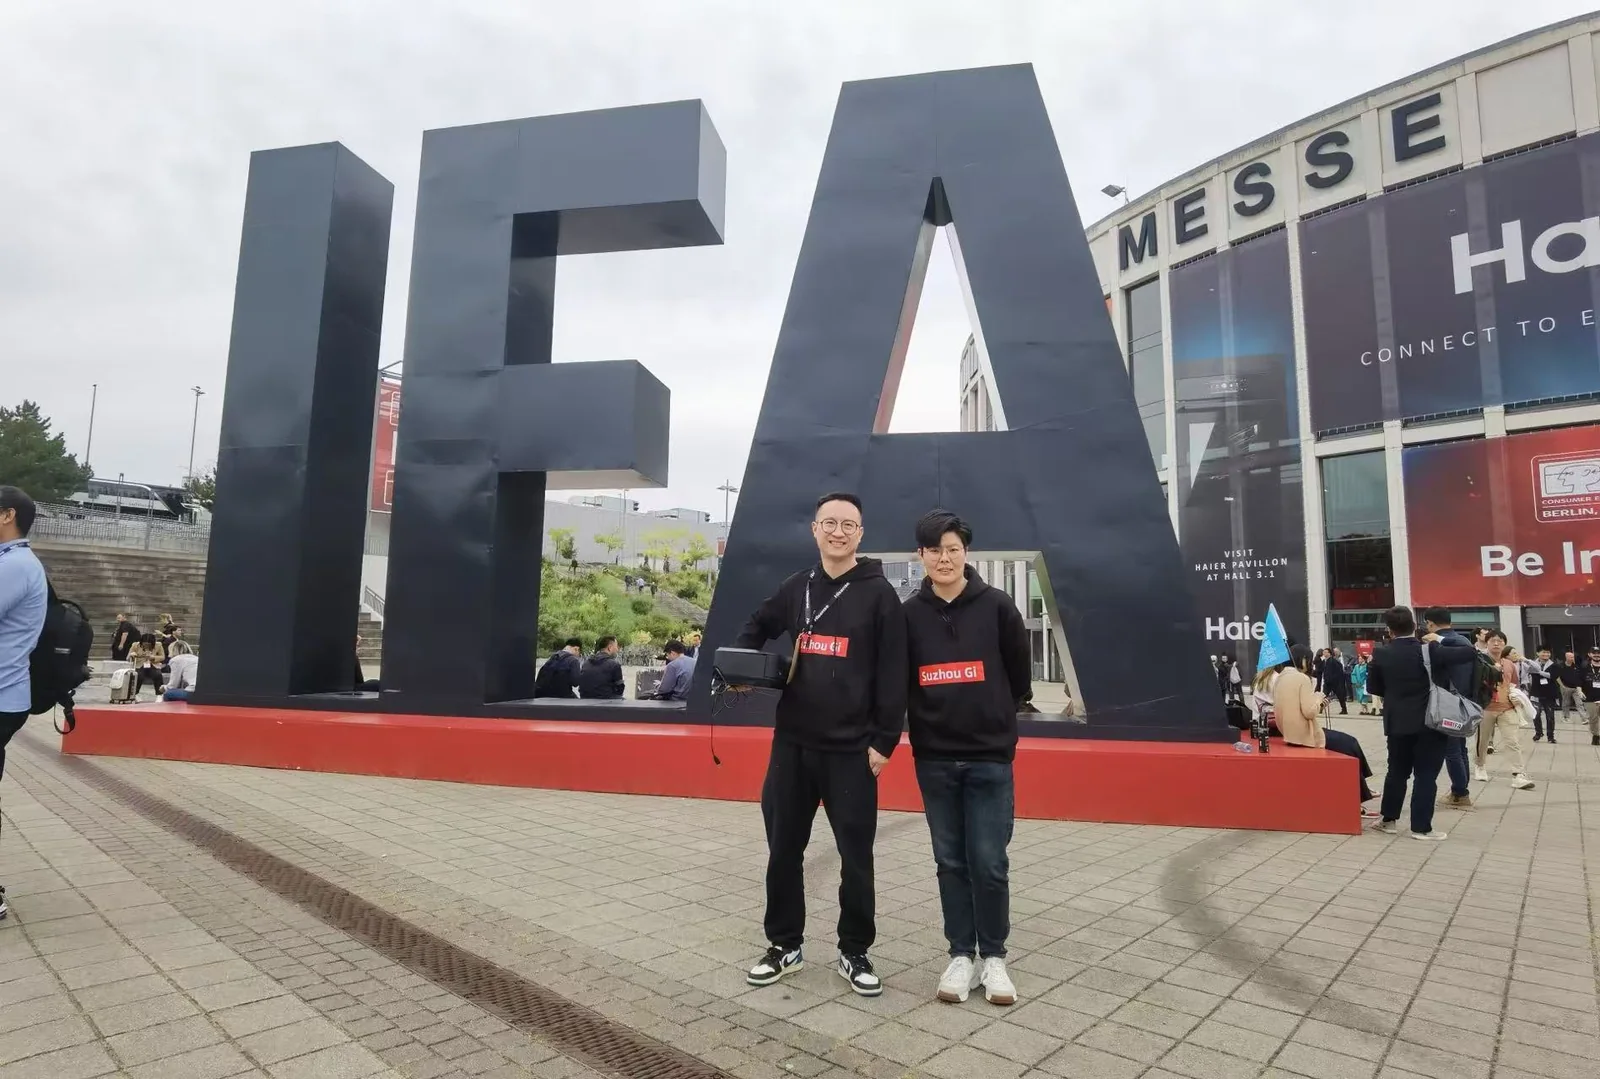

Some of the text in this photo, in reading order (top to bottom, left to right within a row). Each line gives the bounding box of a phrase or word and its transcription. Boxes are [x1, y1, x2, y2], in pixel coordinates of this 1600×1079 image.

[1118, 93, 1447, 271] MESSE
[1360, 326, 1496, 366] CONNECT
[1516, 317, 1556, 337] TO
[192, 63, 1237, 742] IFA
[1541, 496, 1592, 505] CONSUMER
[1195, 557, 1288, 572] HAIER PAVILLON
[1223, 548, 1254, 559] VISIT
[1480, 544, 1544, 577] Be
[1206, 570, 1276, 581] AT HALL 3.1
[1205, 614, 1266, 641] Haie
[921, 660, 977, 682] Suzhou Gi
